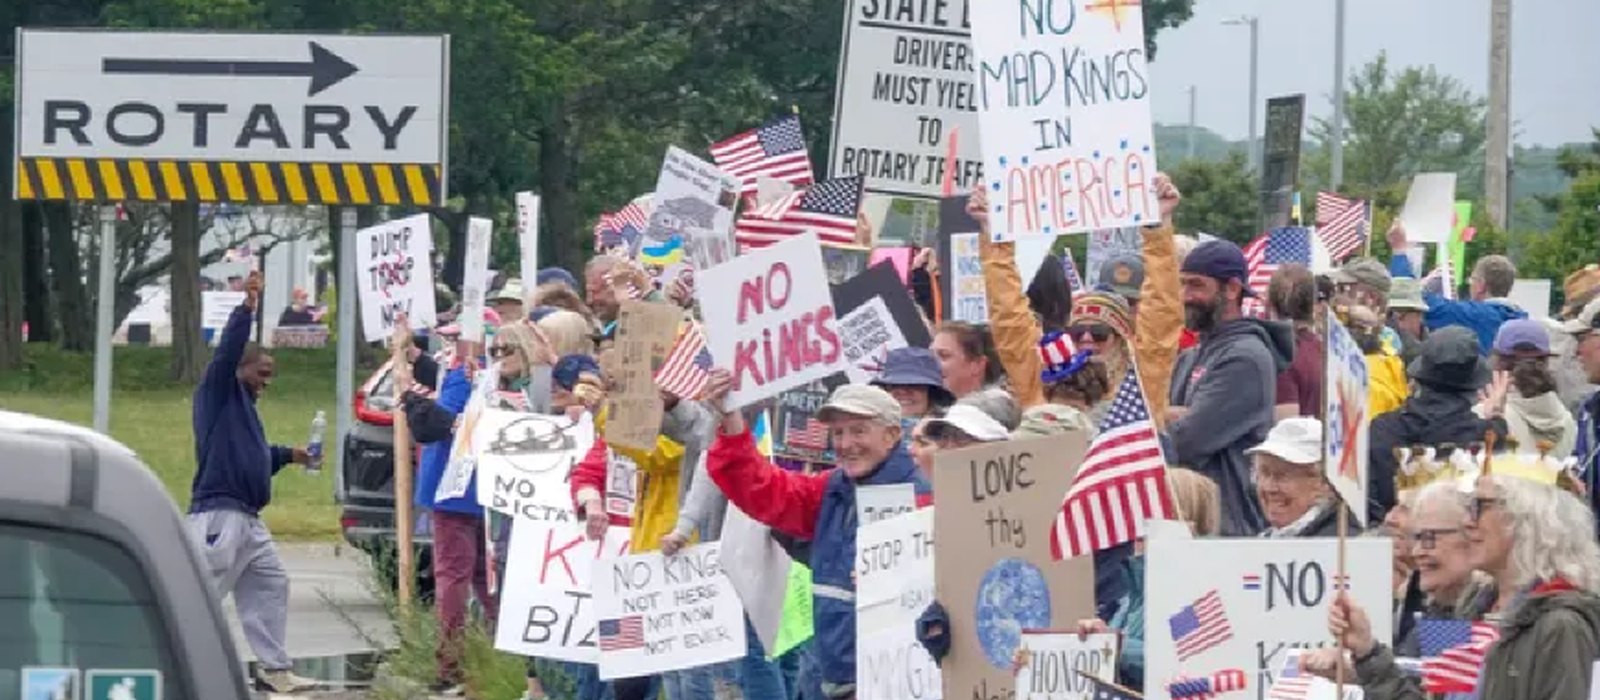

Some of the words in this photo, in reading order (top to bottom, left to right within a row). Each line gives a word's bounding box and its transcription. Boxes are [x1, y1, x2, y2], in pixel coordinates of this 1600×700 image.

[861, 0, 947, 27] STATE
[1020, 0, 1075, 38] NO
[872, 72, 931, 106] MUST
[936, 78, 977, 112] YIEL
[980, 51, 1056, 111] MAD
[1062, 46, 1148, 106] KINGS
[43, 100, 418, 150] ROTARY
[917, 115, 942, 147] TO
[1033, 116, 1072, 151] IN
[842, 147, 920, 183] ROTARY
[922, 155, 984, 189] TRAFF
[1007, 153, 1150, 234] AMERICA
[738, 262, 792, 324] NO
[731, 305, 841, 391] KINGS
[494, 474, 536, 498] NO
[970, 452, 1035, 503] LOVE
[492, 494, 570, 522] DICTA
[985, 506, 1026, 548] thy
[613, 561, 651, 594] NO
[664, 549, 723, 584] KING
[861, 539, 902, 575] STOP
[913, 531, 934, 559] TH
[624, 591, 662, 613] NOT
[674, 584, 719, 606] HERE
[1264, 559, 1326, 612] NO
[648, 612, 678, 633] NOT
[681, 604, 714, 624] NOW
[645, 636, 677, 656] NOT
[683, 626, 734, 649] EVER
